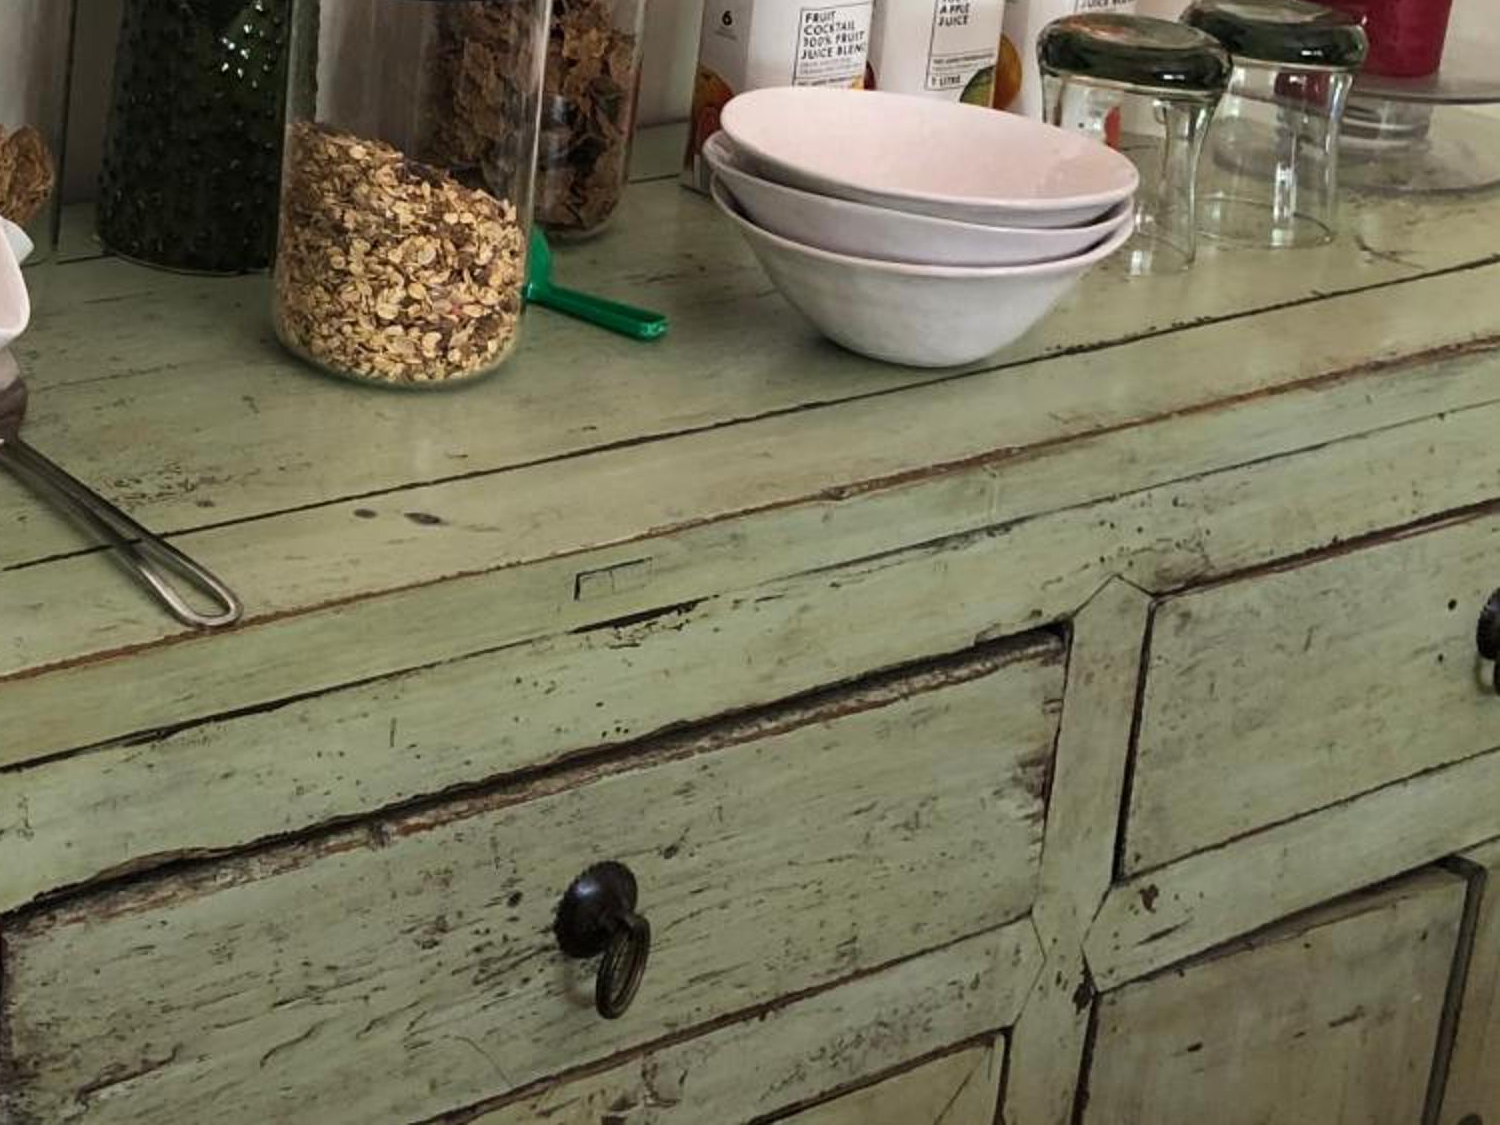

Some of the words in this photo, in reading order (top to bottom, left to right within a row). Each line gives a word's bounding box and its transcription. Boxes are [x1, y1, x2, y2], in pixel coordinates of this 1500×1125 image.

[721, 10, 733, 26] 6
[805, 10, 837, 24] FRUIT
[938, 15, 969, 27] JUICE
[803, 21, 856, 36] COCKTAIL
[835, 31, 866, 45] FRUIT
[801, 44, 834, 60] JUICE
